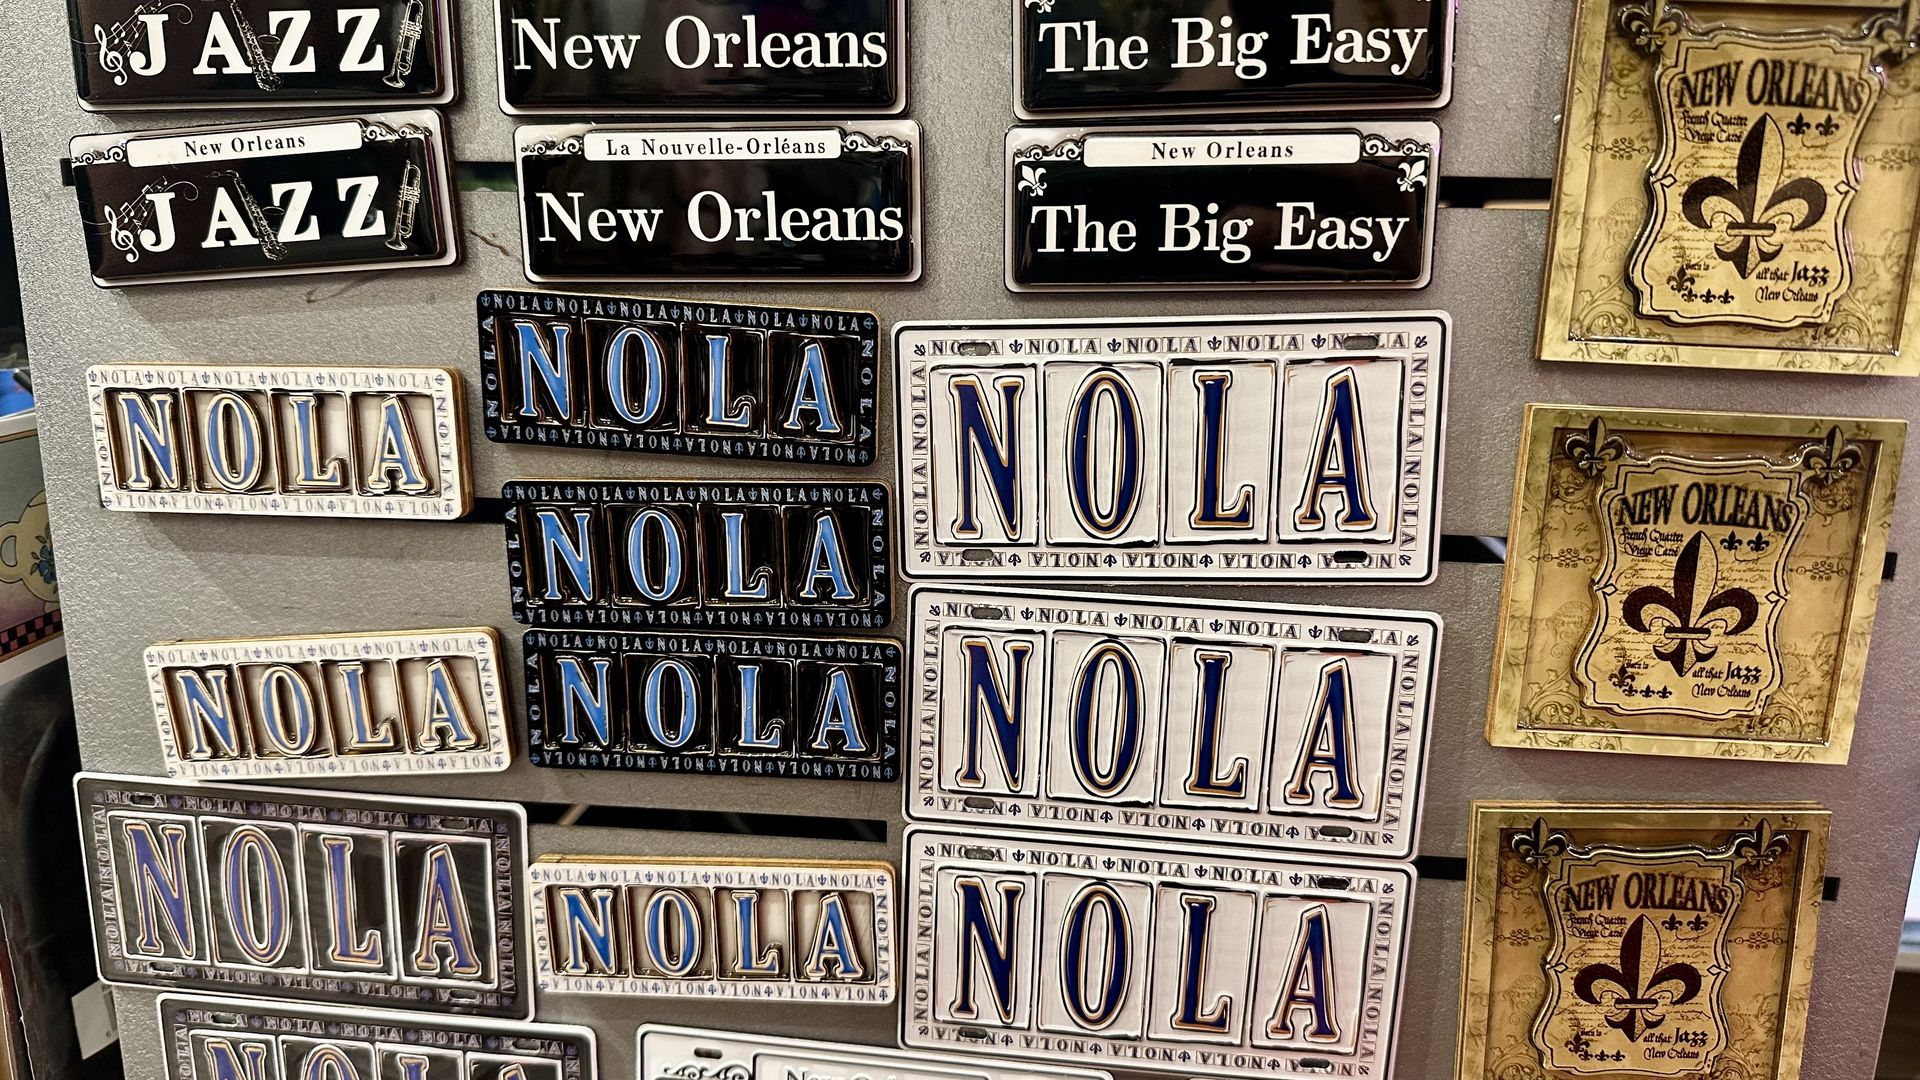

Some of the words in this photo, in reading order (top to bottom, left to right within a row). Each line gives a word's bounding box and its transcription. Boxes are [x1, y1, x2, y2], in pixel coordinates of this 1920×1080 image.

[128, 9, 384, 76] JAZZ
[512, 18, 640, 71] New
[665, 15, 888, 70] Orleans
[1038, 20, 1148, 73] The
[1171, 16, 1269, 80] Big
[1290, 13, 1428, 75] Easy
[1676, 60, 1744, 108] NEW
[1747, 58, 1864, 114] ORLEANS
[184, 139, 220, 157] New
[231, 133, 306, 152] Orleans
[606, 139, 630, 156] La
[641, 137, 826, 156] Nouvelle-Orléans
[1151, 142, 1197, 160] New
[1206, 141, 1294, 159] Orleans
[138, 176, 386, 252] JAZZ
[536, 192, 663, 242] New
[687, 190, 902, 242] Orleans
[1031, 204, 1136, 253] The
[1158, 202, 1254, 264] Big
[1274, 201, 1409, 262] Easy
[1791, 261, 1829, 287] Jazz
[1755, 286, 1780, 303] New
[495, 295, 540, 311] NOLA
[557, 298, 604, 316] NOLA
[621, 302, 667, 319] NOLA
[684, 306, 731, 324] NOLA
[748, 310, 795, 328] NOLA
[812, 314, 859, 332] NOLA
[1026, 338, 1098, 354] NOLA
[1124, 336, 1197, 353] NOLA
[1225, 334, 1300, 351] NOLA
[100, 370, 143, 385] NOLA
[157, 371, 199, 385] NOLA
[214, 372, 256, 386] NOLA
[271, 372, 313, 386] NOLA
[328, 373, 372, 387] NOLA
[387, 374, 432, 388] NOLA
[515, 323, 843, 434] NOLA
[119, 392, 428, 491] NOLA
[949, 368, 1378, 541] NOLA
[516, 486, 561, 500] NOLA
[577, 486, 623, 501] NOLA
[639, 486, 684, 501] NOLA
[700, 487, 745, 501] NOLA
[761, 487, 806, 502] NOLA
[823, 487, 869, 502] NOLA
[1616, 484, 1679, 526] NEW
[1682, 482, 1793, 533] ORLEANS
[536, 511, 855, 601] NOLA
[1037, 608, 1107, 626] NOLA
[1130, 615, 1202, 632] NOLA
[1226, 621, 1298, 638] NOLA
[158, 651, 198, 663] NOLA
[211, 648, 251, 661] NOLA
[265, 646, 305, 659] NOLA
[320, 644, 360, 656] NOLA
[375, 641, 417, 654] NOLA
[431, 639, 474, 652] NOLA
[538, 633, 583, 648] NOLA
[598, 635, 642, 650] NOLA
[657, 637, 702, 652] NOLA
[717, 639, 761, 654] NOLA
[777, 641, 821, 656] NOLA
[837, 643, 882, 659] NOLA
[1691, 683, 1715, 698] New
[1717, 684, 1751, 697] Orleans
[1723, 661, 1762, 685] Jazz
[177, 660, 478, 758] NOLA
[557, 658, 866, 752] NOLA
[956, 636, 1364, 809] NOLA
[184, 797, 244, 814] NOLA
[263, 803, 325, 821] NOLA
[344, 809, 407, 827] NOLA
[543, 869, 586, 881] NOLA
[600, 870, 642, 882] NOLA
[657, 870, 698, 883] NOLA
[714, 872, 757, 884] NOLA
[772, 873, 815, 885] NOLA
[830, 875, 874, 887] NOLA
[1028, 850, 1095, 868] NOLA
[1118, 858, 1187, 877] NOLA
[1210, 866, 1280, 884] NOLA
[124, 819, 481, 976] NOLA
[1562, 874, 1620, 912] NEW
[1623, 872, 1728, 914] ORLEANS
[559, 886, 864, 976] NOLA
[949, 874, 1340, 1042] NOLA
[264, 1016, 324, 1033] NOLA
[340, 1023, 401, 1040] NOLA
[420, 1031, 481, 1047] NOLA
[1672, 1027, 1708, 1047] Jazz
[1644, 1048, 1665, 1060] New
